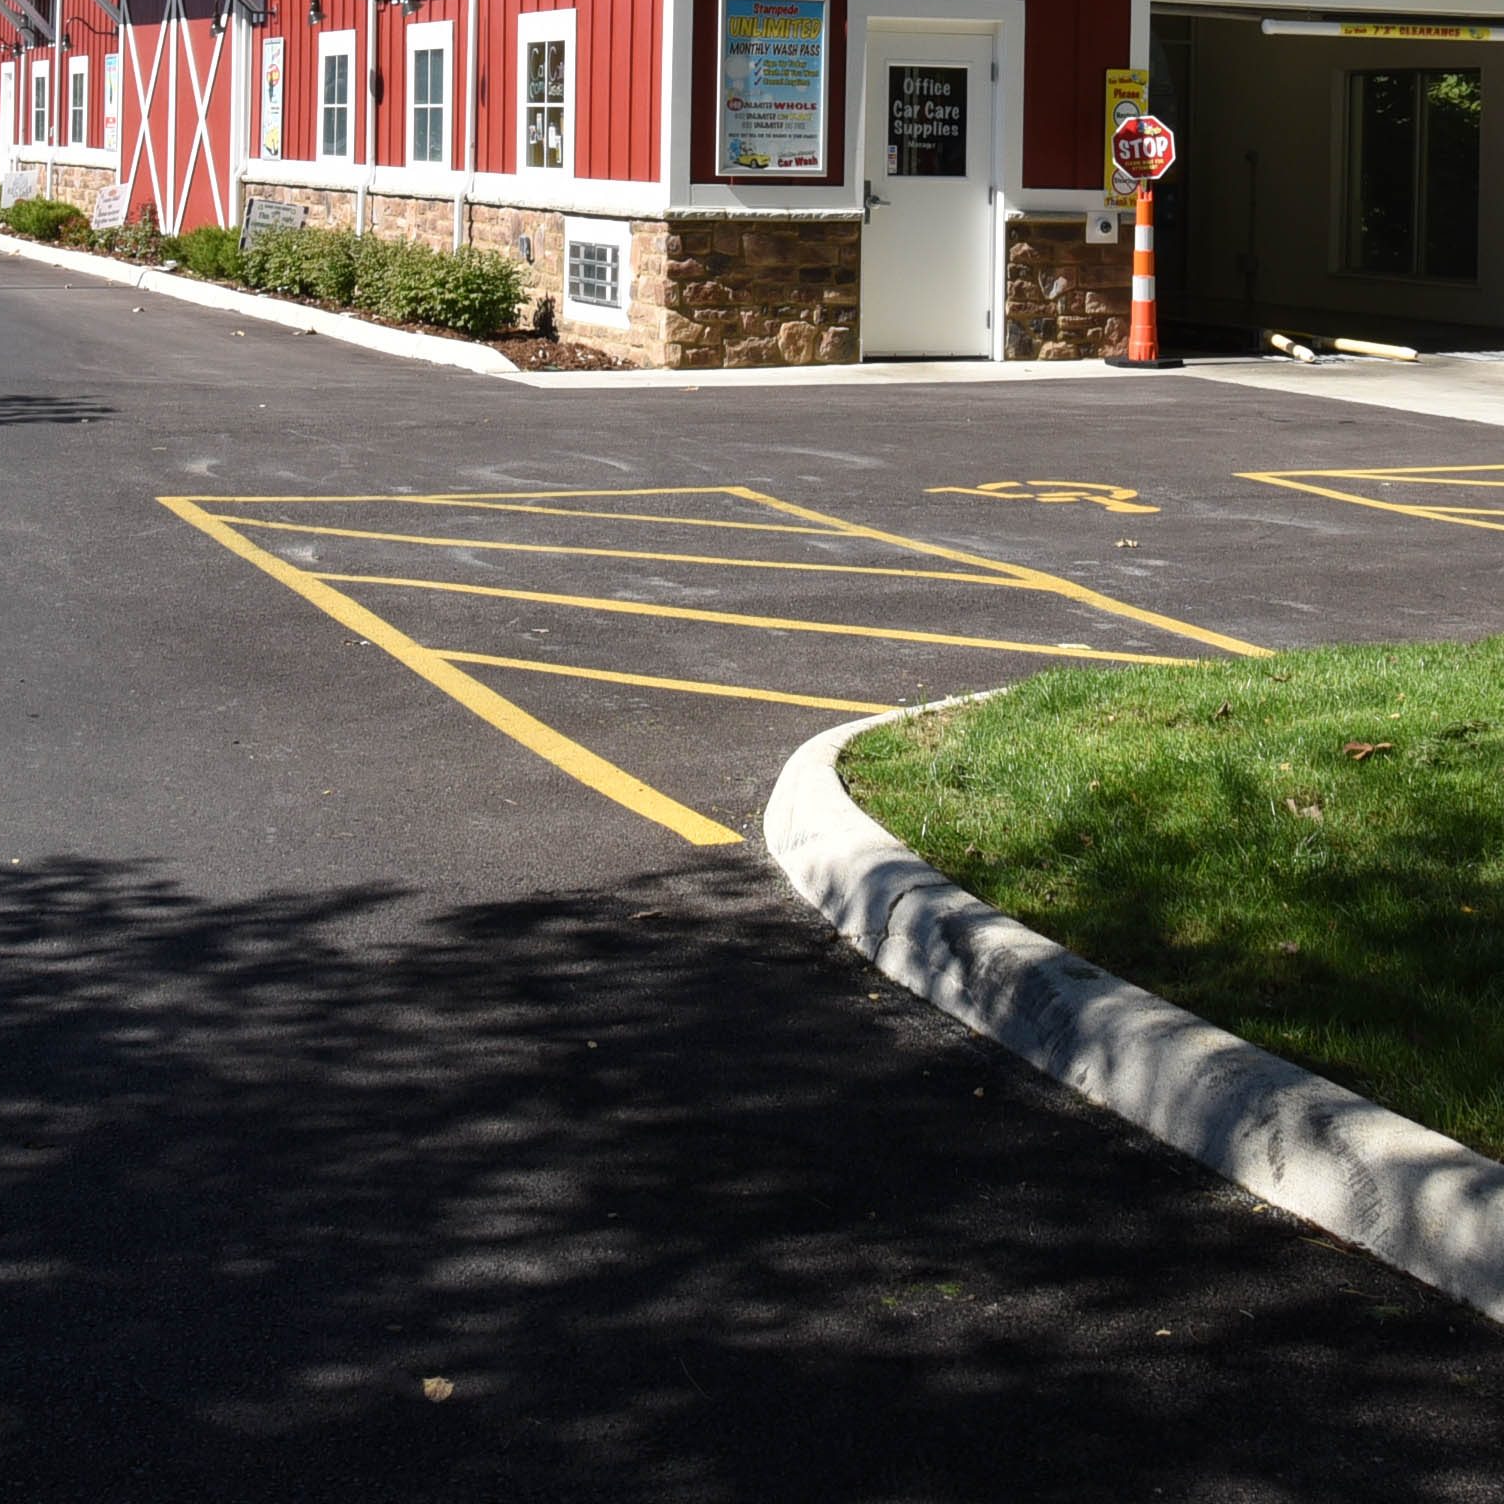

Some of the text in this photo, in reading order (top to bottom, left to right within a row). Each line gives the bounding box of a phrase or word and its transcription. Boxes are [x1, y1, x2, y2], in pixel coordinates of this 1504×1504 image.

[754, 3, 798, 16] Stampede
[729, 16, 822, 39] UNLIMITED
[1399, 27, 1461, 37] CLEARANCE
[730, 43, 820, 57] MONTHLY WASH PASS
[903, 78, 951, 96] Office
[1113, 88, 1140, 99] Please
[893, 100, 960, 119] Car Care
[894, 120, 959, 139] Supplies
[1119, 136, 1168, 160] STOP
[778, 156, 818, 167] Car Wash
